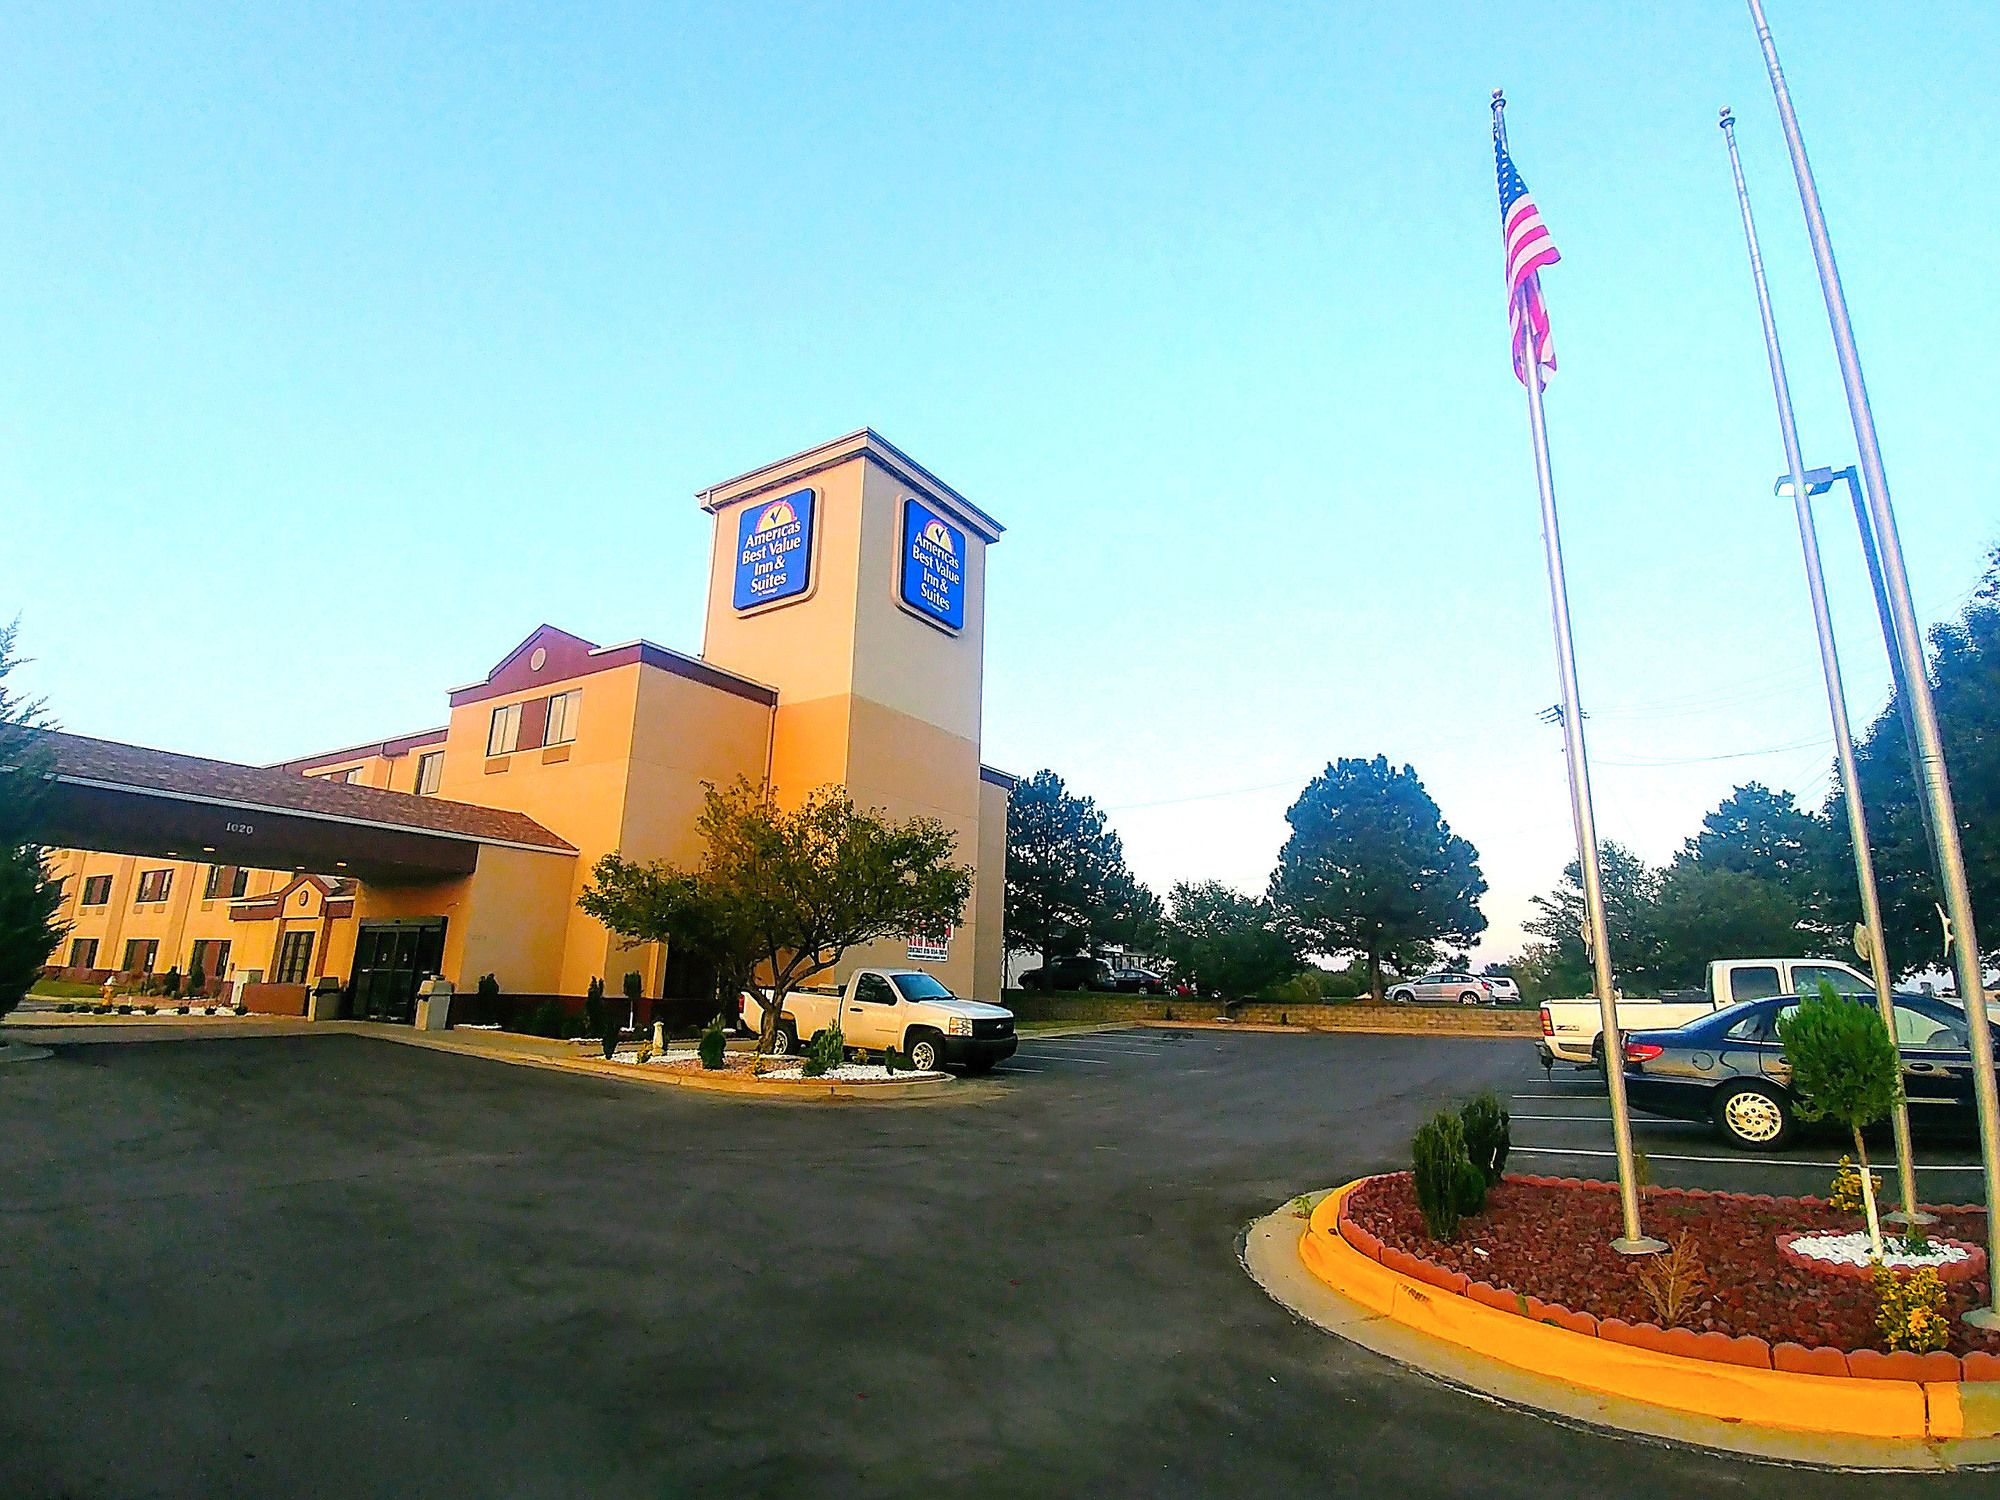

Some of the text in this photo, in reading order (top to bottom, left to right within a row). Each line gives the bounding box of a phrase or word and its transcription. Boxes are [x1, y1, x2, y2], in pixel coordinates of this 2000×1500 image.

[745, 521, 801, 549] Americas
[742, 537, 801, 565] Best Value
[912, 544, 960, 585] Best Value
[915, 532, 959, 569] Americas
[754, 555, 785, 576] Inn &
[751, 573, 787, 594] Suites
[923, 568, 949, 594] Inn &
[921, 583, 950, 611] Suites
[226, 822, 253, 835] 1020
